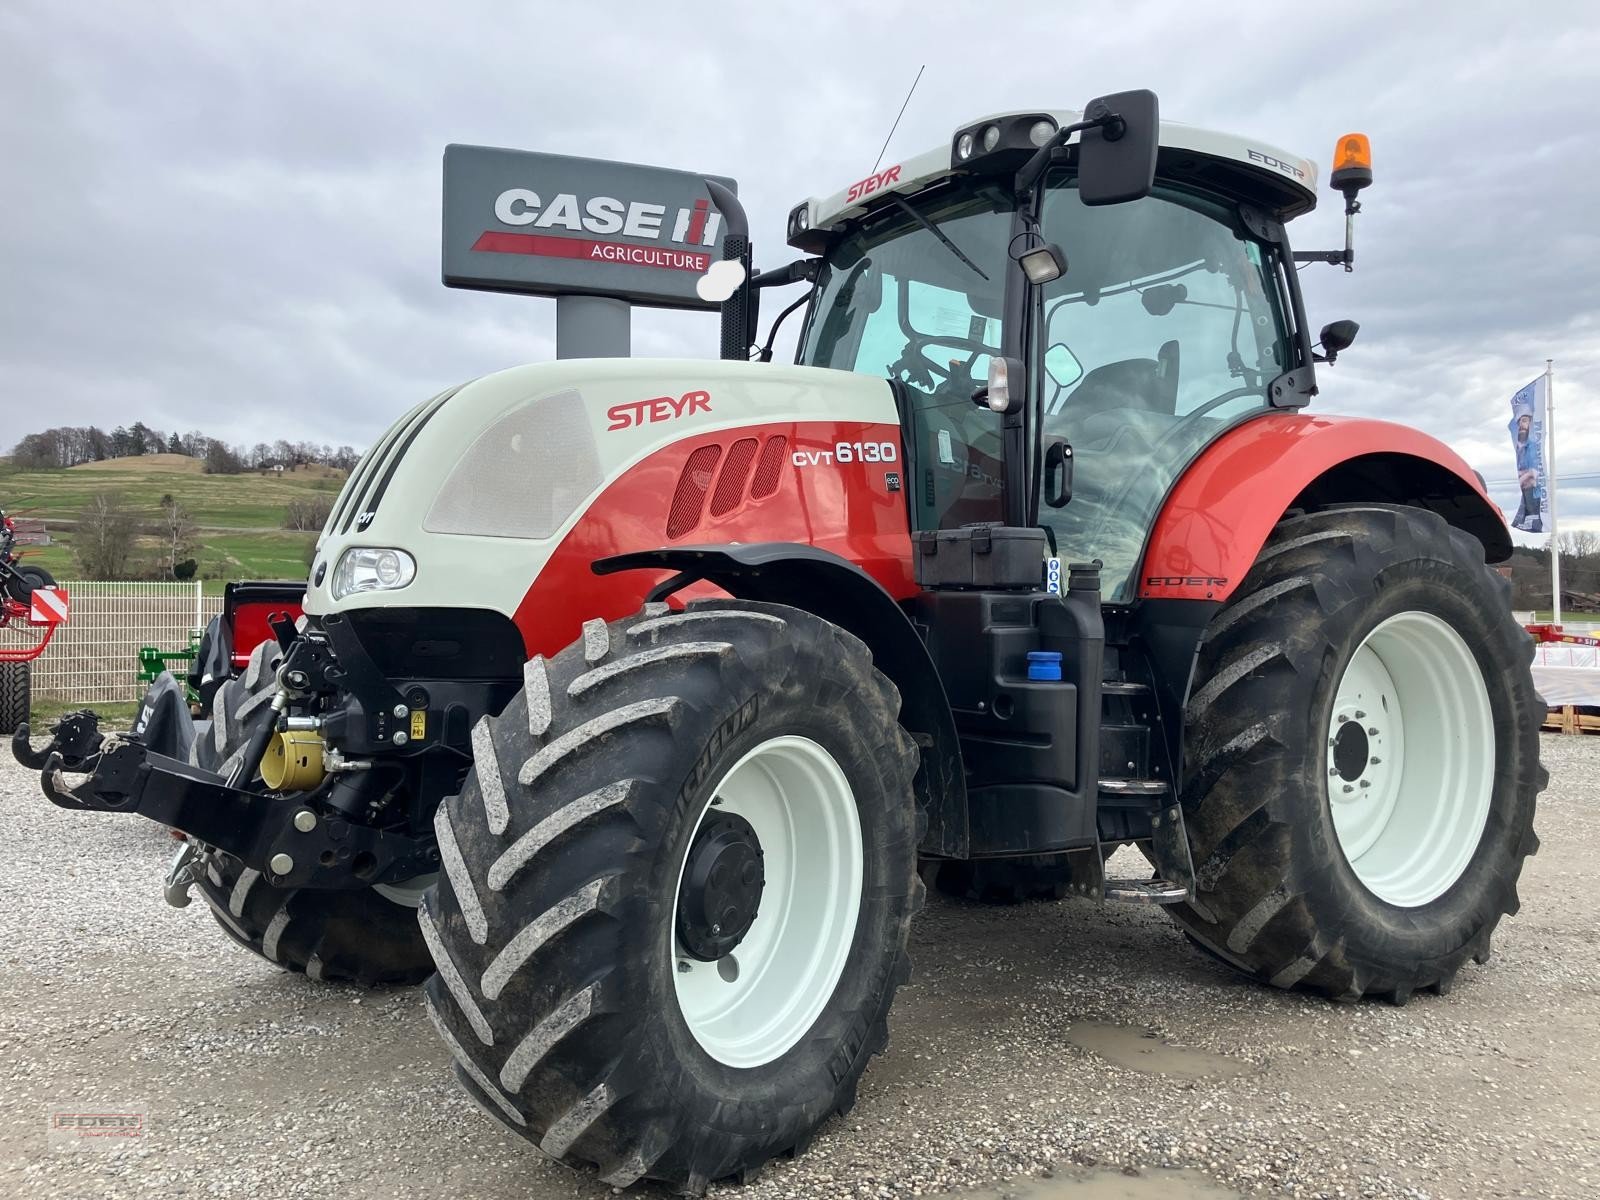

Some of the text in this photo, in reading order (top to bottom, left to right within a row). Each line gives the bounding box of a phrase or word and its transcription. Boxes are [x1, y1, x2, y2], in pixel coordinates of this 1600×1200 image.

[1247, 149, 1305, 180] EDER
[846, 165, 902, 204] STEYR
[494, 188, 667, 240] CASE
[591, 244, 704, 271] AGRICULTURE
[606, 390, 713, 432] STEYR
[791, 441, 898, 467] CVT 6130
[357, 512, 375, 524] CVT
[1146, 576, 1229, 587] EDER
